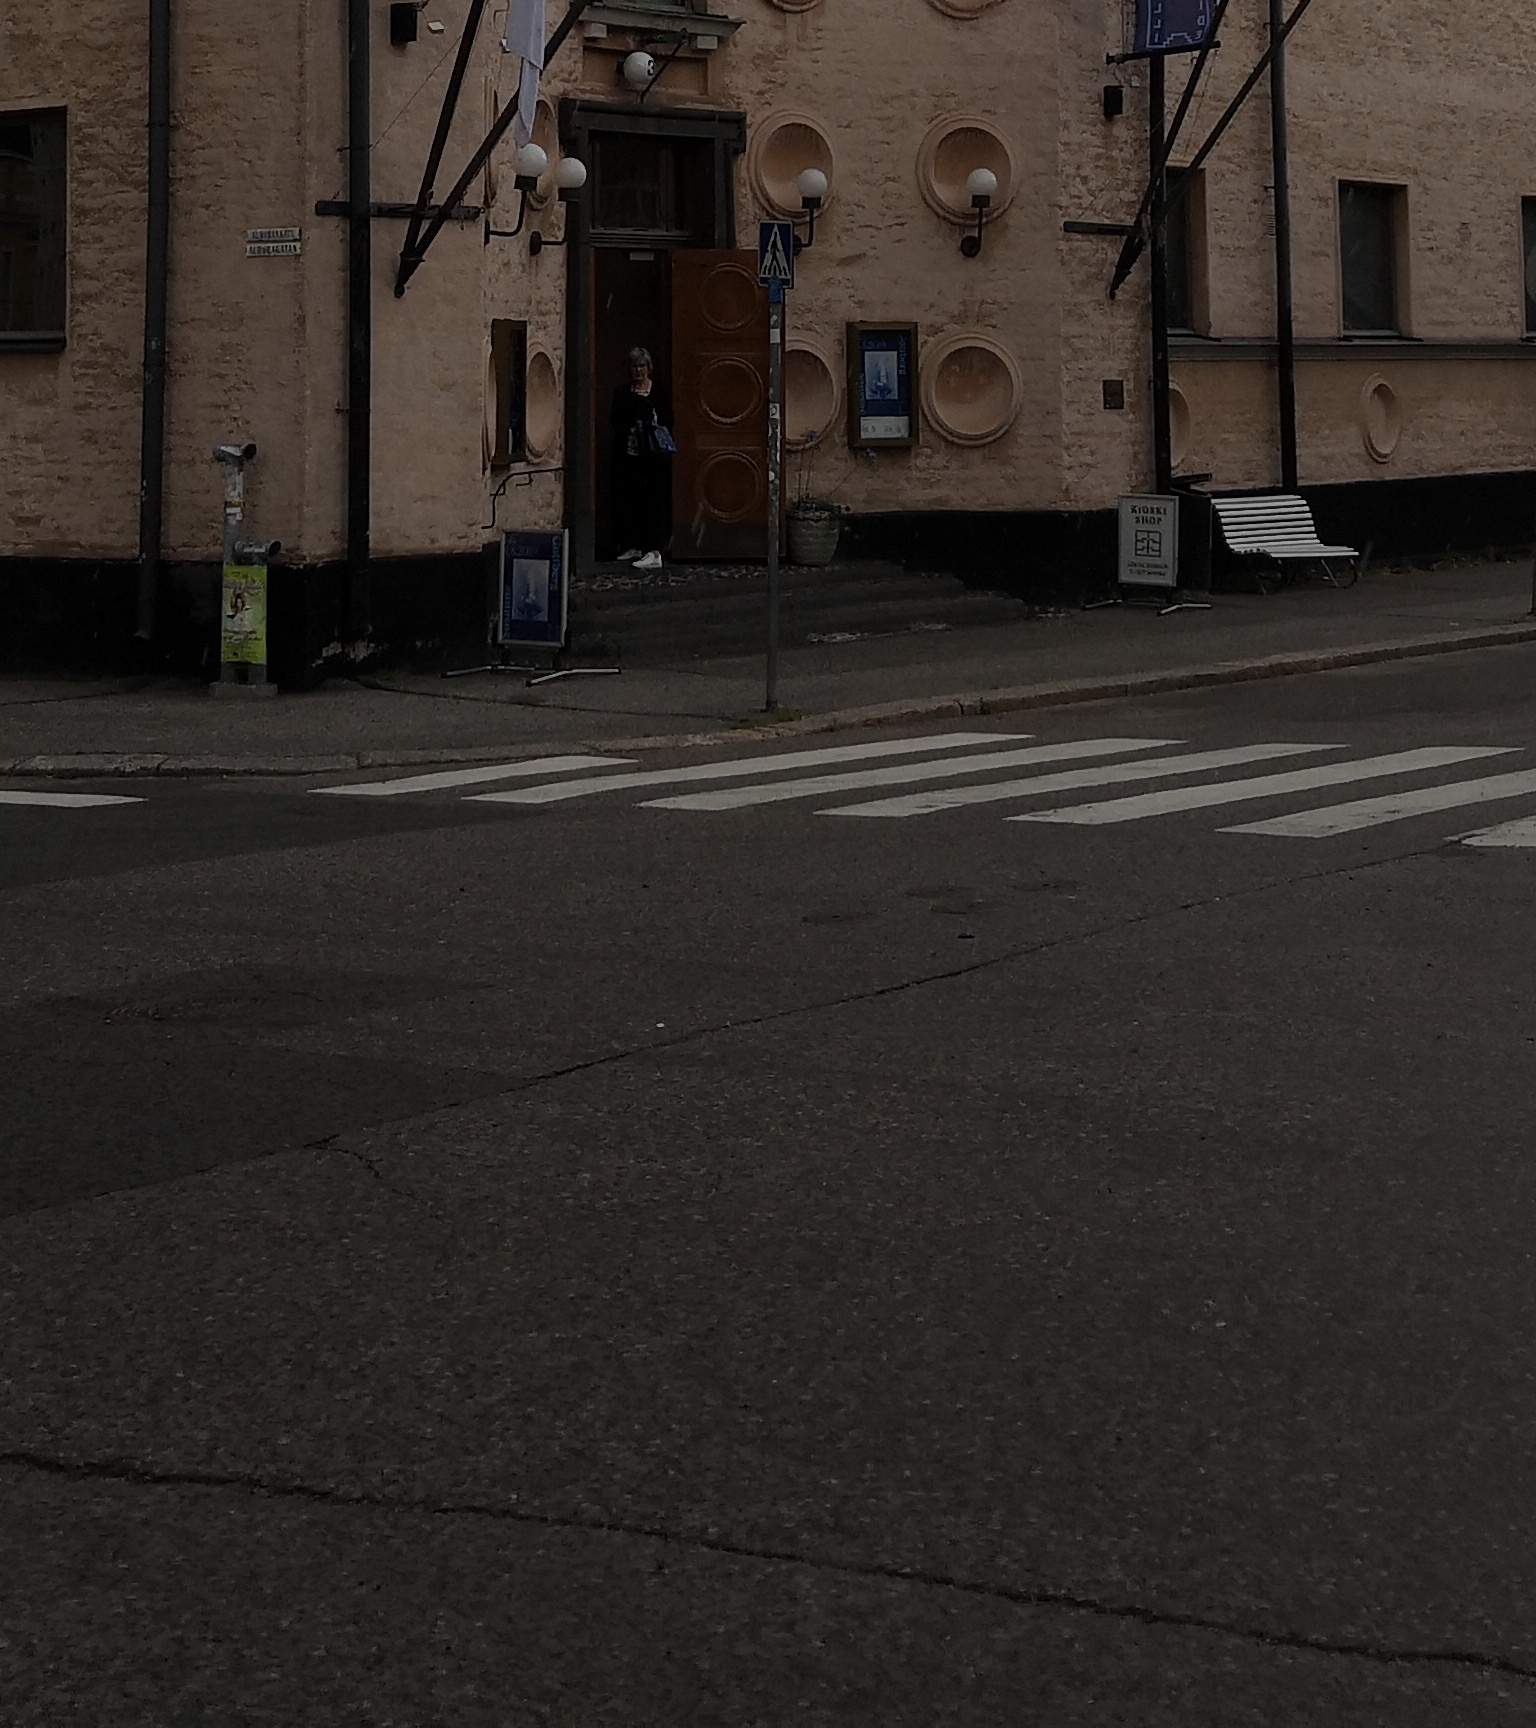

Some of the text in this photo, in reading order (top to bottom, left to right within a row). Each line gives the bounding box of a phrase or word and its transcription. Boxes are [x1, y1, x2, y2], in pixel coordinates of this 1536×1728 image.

[647, 59, 654, 77] 3
[1131, 504, 1167, 516] KIOSKI
[1135, 516, 1163, 525] SHOP
